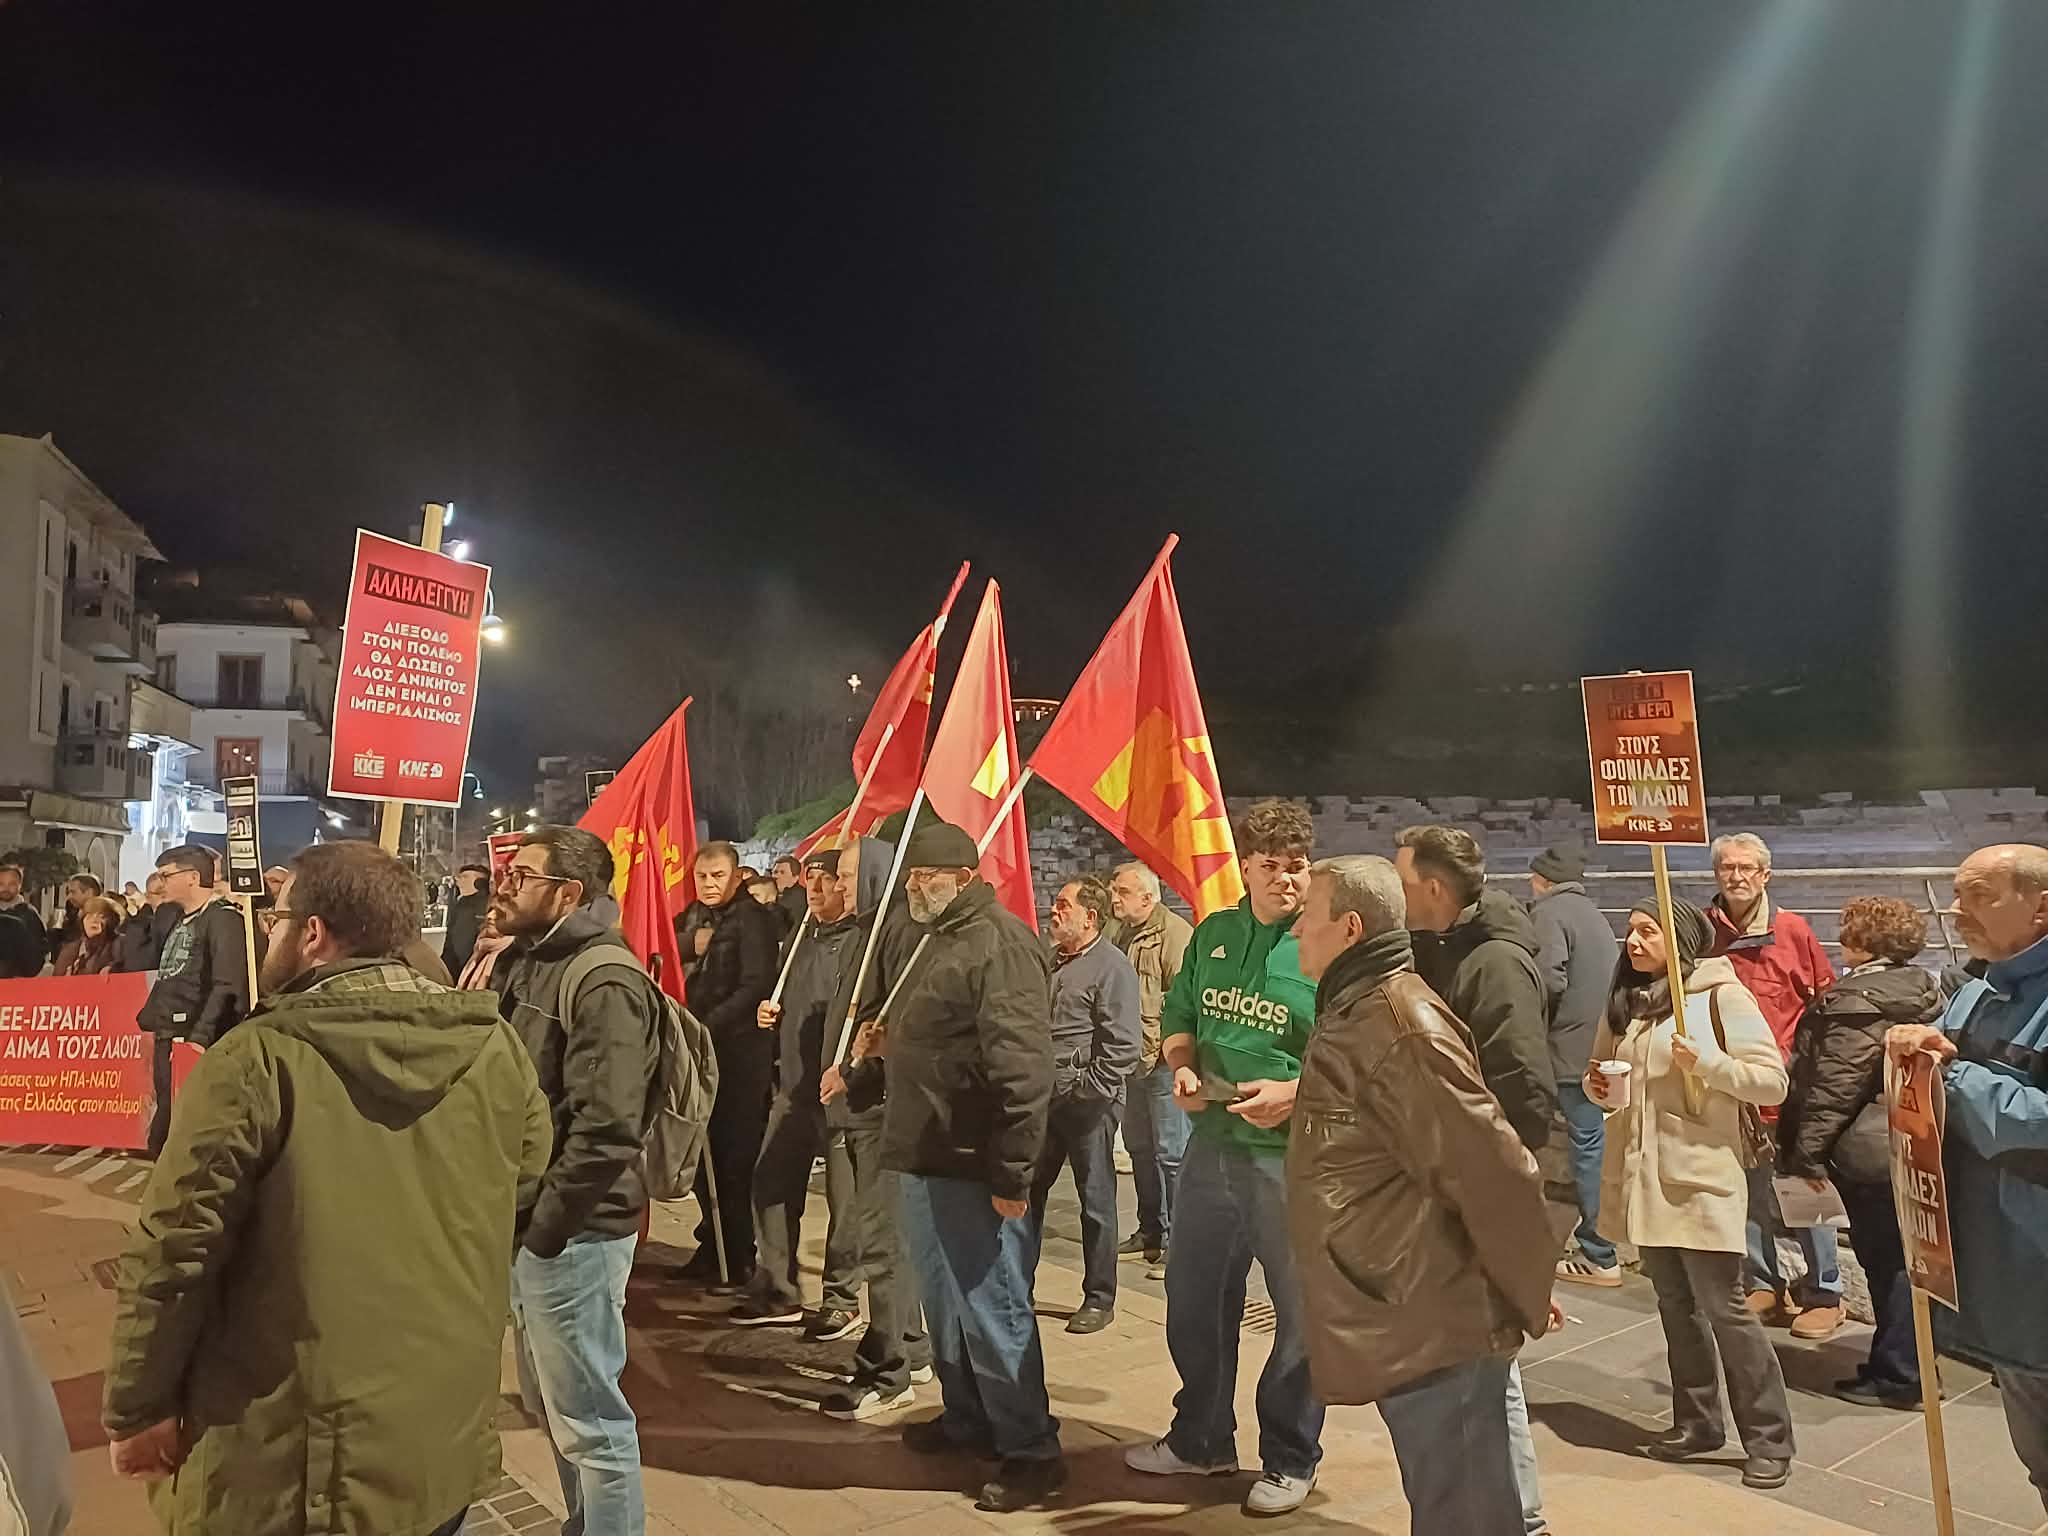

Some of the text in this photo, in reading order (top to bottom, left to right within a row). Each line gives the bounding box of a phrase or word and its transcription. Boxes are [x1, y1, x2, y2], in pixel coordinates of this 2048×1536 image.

[368, 569, 470, 615] ΑΛΛΗΛΕΓΓΥΗ
[384, 621, 449, 645] ΔΙΕΞΟΔΟ
[362, 631, 463, 664] ΣΤΟΝ ΠΟΛΕΜΟ
[370, 650, 455, 677] ΘΑ ΔΩΣΕΙ Ο
[352, 664, 467, 696] ΛΑΟΣ ΑΝΙΚΗΤΟΣ
[365, 682, 453, 708] ΔΕΝ ΕΙΝΑΙ Ο
[350, 695, 462, 725] ΙΜΠΕΡΙΑΛΙΣΜΟΣ
[1617, 735, 1661, 755] ΣΤΟΥΣ
[353, 757, 385, 775] ΚΚΕ
[398, 759, 430, 778] ΚΝΕ
[1600, 757, 1691, 781] ΦΟΝΙΑΔΕΣ
[1606, 784, 1689, 807] ΤΩΝ ΛΑΩΝ
[1628, 818, 1656, 832] ΚΝΕ
[1202, 986, 1289, 1025] adidas
[1202, 1007, 1285, 1036] SPORTSWEAR
[3, 1035, 142, 1059] ΑΙΜΑ ΤΟΥΣ ΛΑΟΥΣ
[34, 1074, 57, 1088] των
[60, 1070, 121, 1088] ΗΠΑ-ΝΑΤΟ!
[0, 1091, 142, 1118] της Ελλάδας στον πόλεμο!
